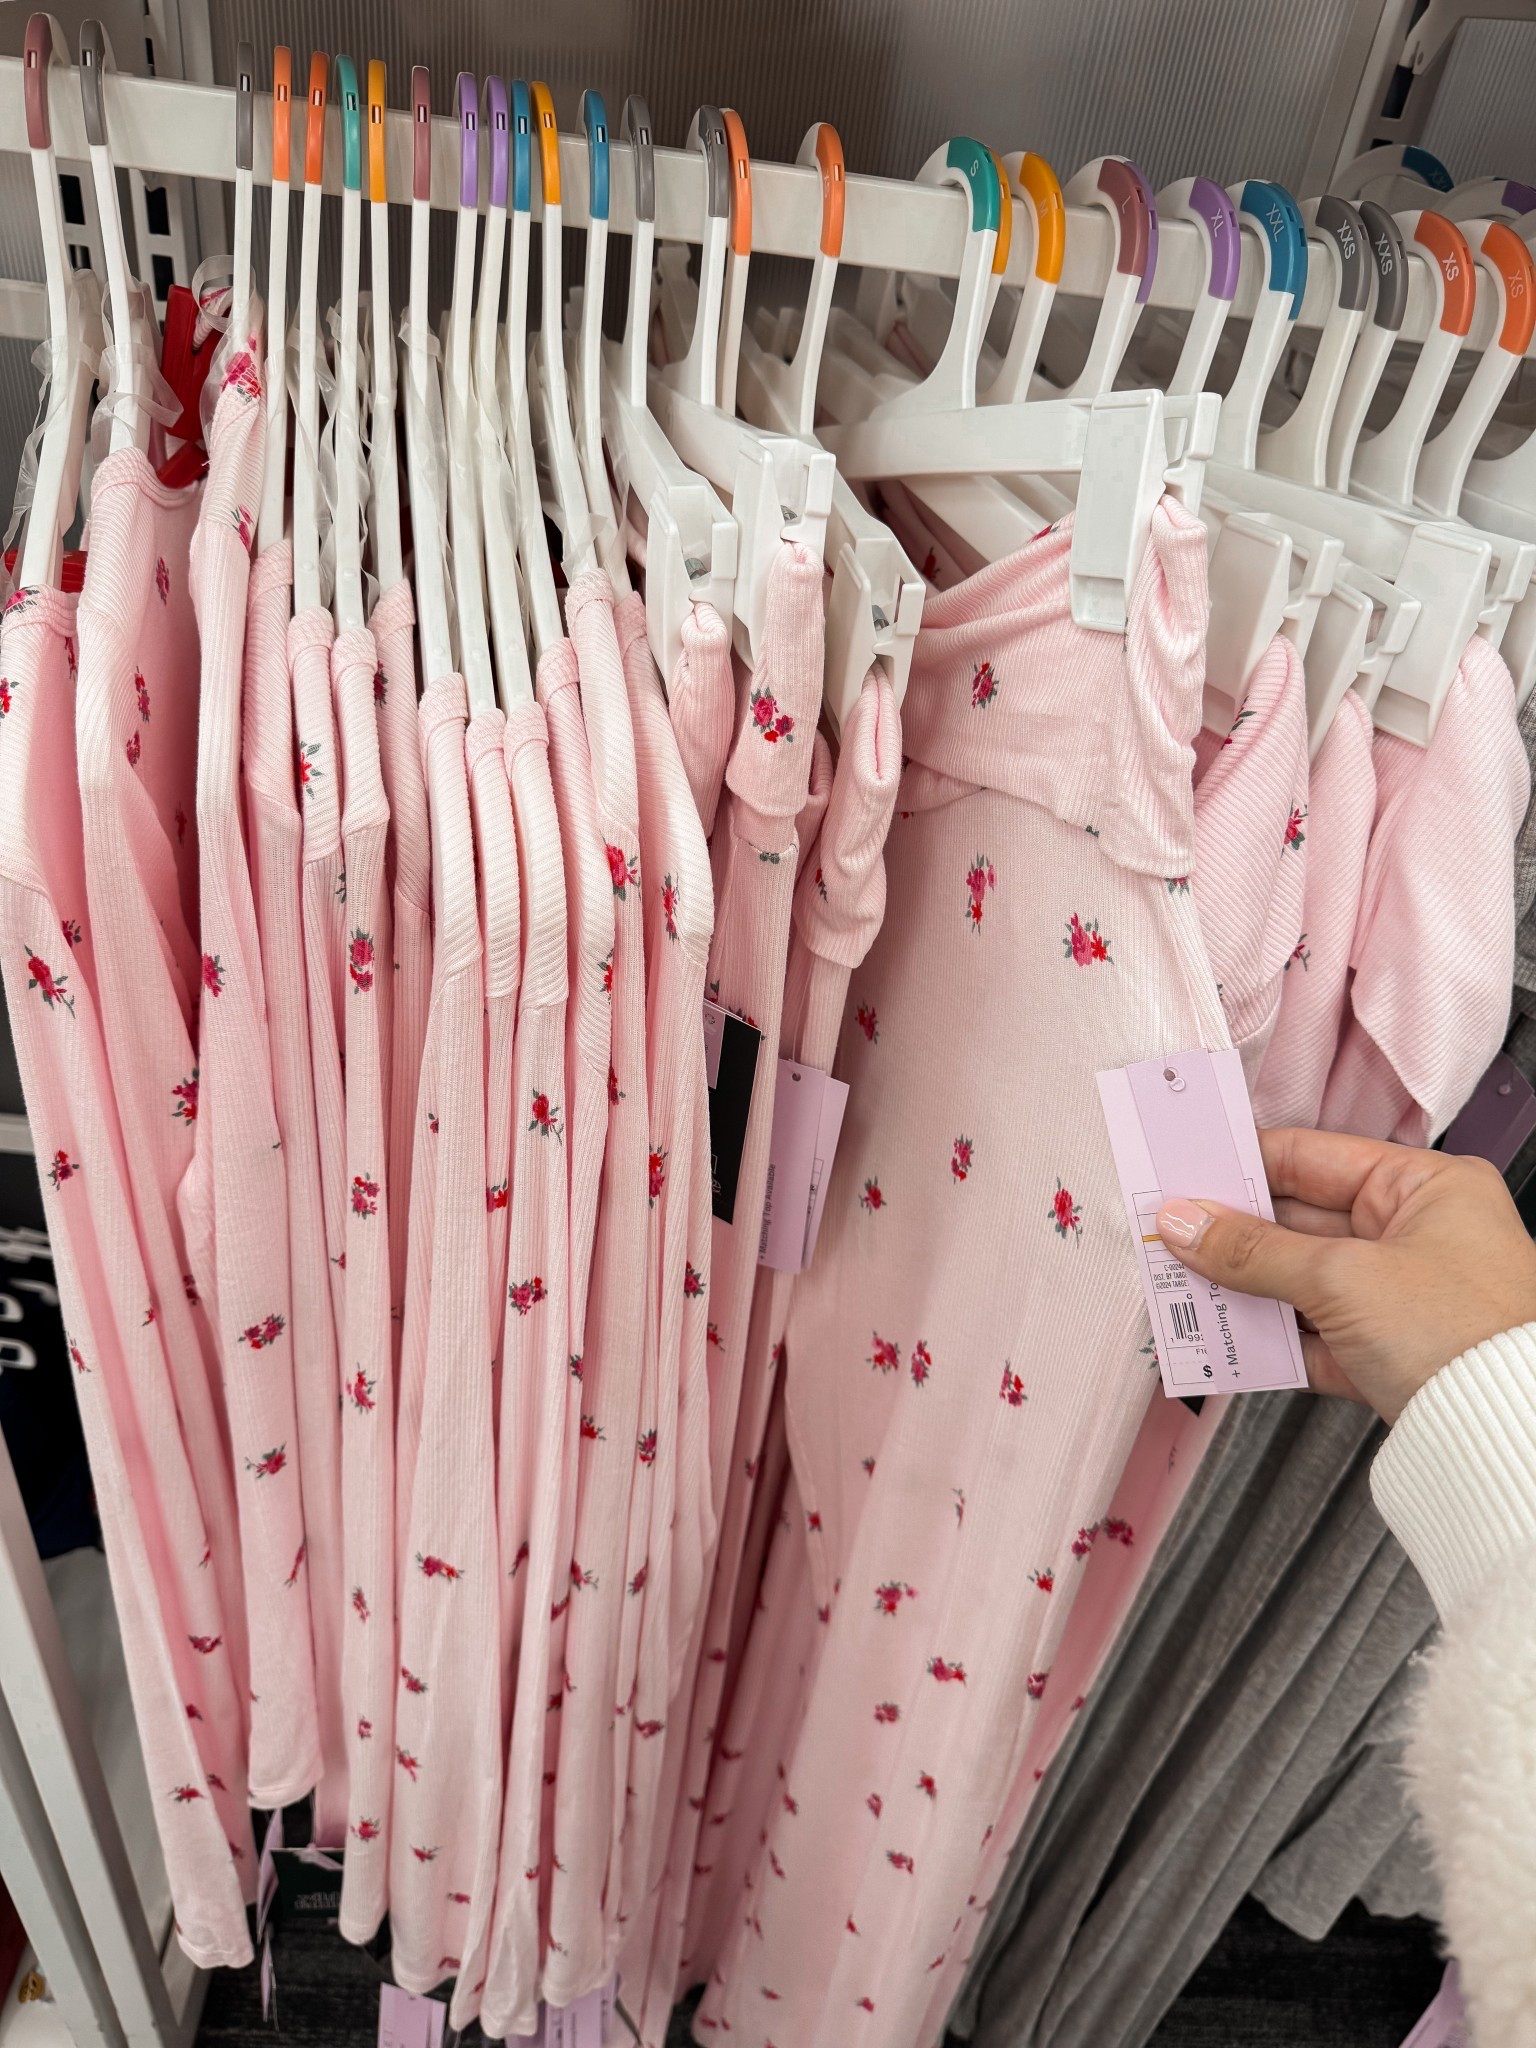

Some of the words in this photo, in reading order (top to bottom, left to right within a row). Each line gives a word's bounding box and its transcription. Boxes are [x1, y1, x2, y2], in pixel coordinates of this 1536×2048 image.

[970, 159, 979, 177] S
[1040, 199, 1049, 218] M
[1121, 195, 1131, 215] L
[1210, 208, 1224, 239] XL
[1266, 202, 1285, 243] XXL
[1337, 219, 1356, 260] XXS
[1375, 232, 1393, 276] XXS
[1442, 251, 1459, 281] XS
[1508, 269, 1524, 298] XS
[765, 1164, 776, 1200] Available
[763, 1201, 773, 1217] Top
[759, 1219, 772, 1254] Matching
[1209, 1282, 1221, 1301] To
[1215, 1303, 1239, 1366] Matching
[1203, 1363, 1213, 1379] $
